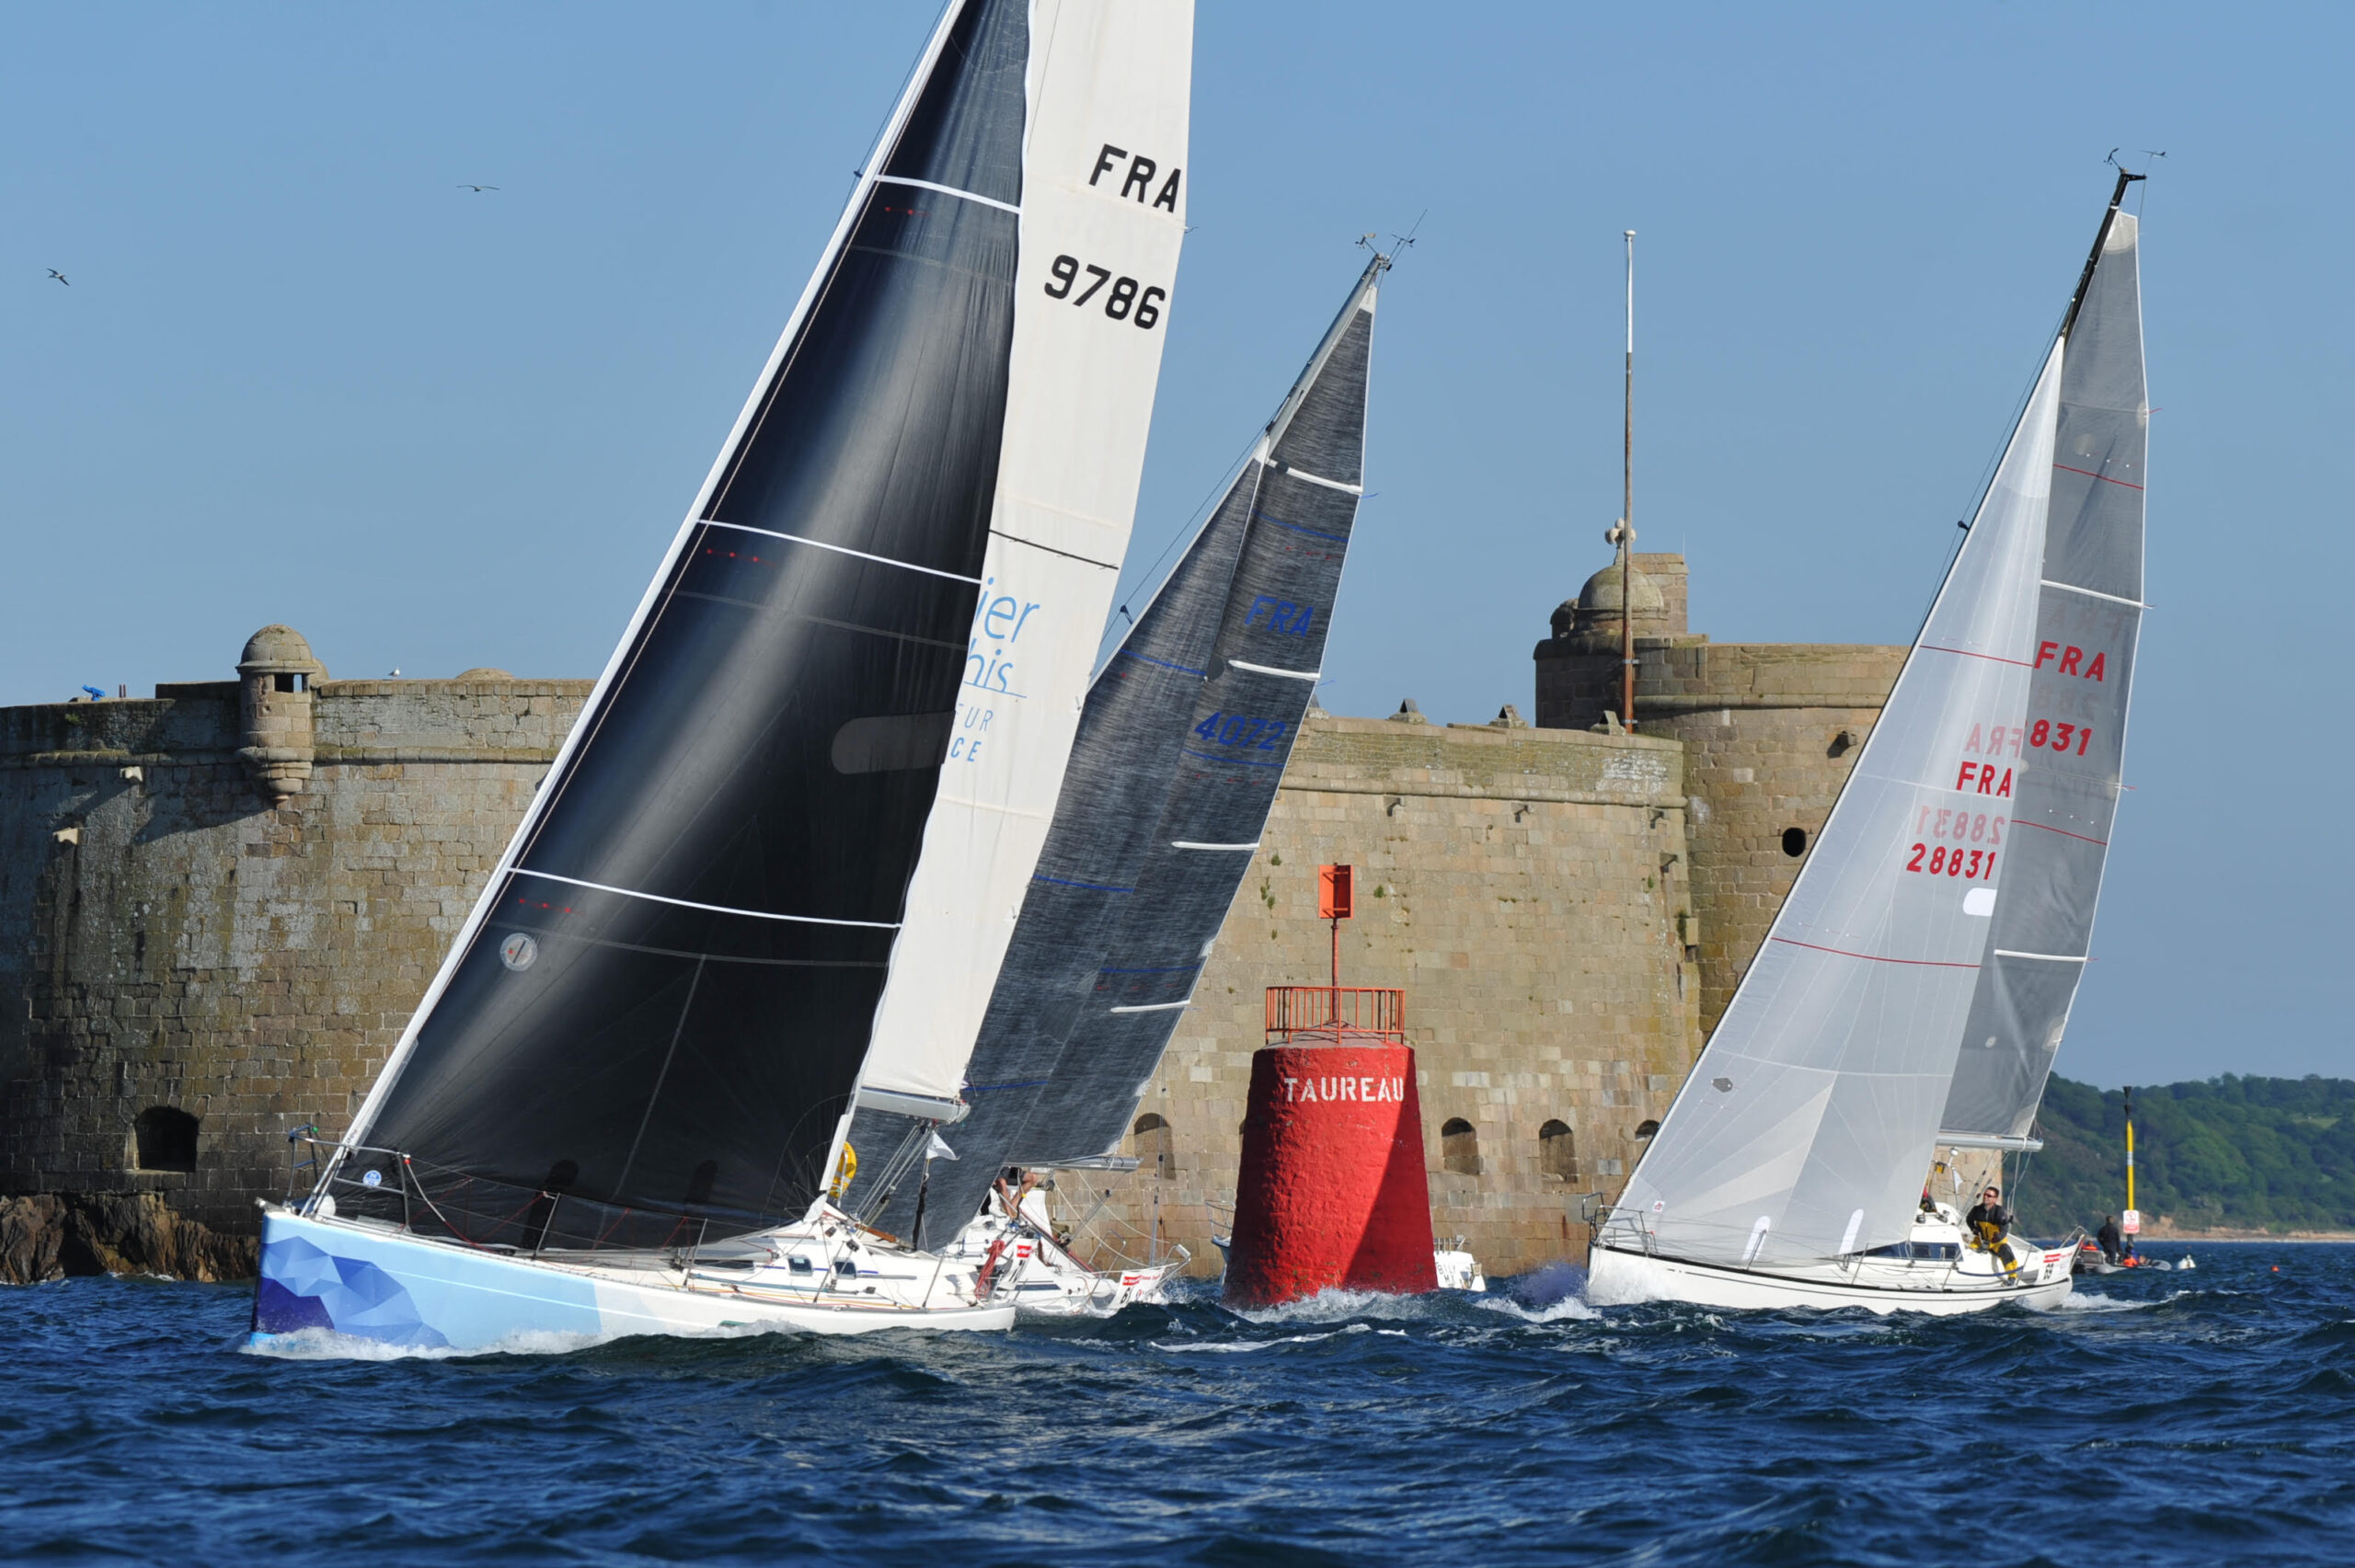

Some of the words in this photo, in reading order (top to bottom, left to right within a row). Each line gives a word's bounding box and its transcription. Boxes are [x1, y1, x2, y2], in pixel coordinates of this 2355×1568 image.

[1088, 143, 1181, 213] FRA
[1043, 254, 1166, 330] 9786
[1244, 594, 1315, 638] FRA
[2034, 640, 2107, 682] FRA
[955, 703, 994, 732] UR
[1193, 711, 1287, 751] 4072
[2025, 718, 2093, 757] 831
[1956, 761, 2013, 798] FRA
[1906, 842, 1997, 881] 28831
[1283, 1076, 1405, 1103] TAUREAU
